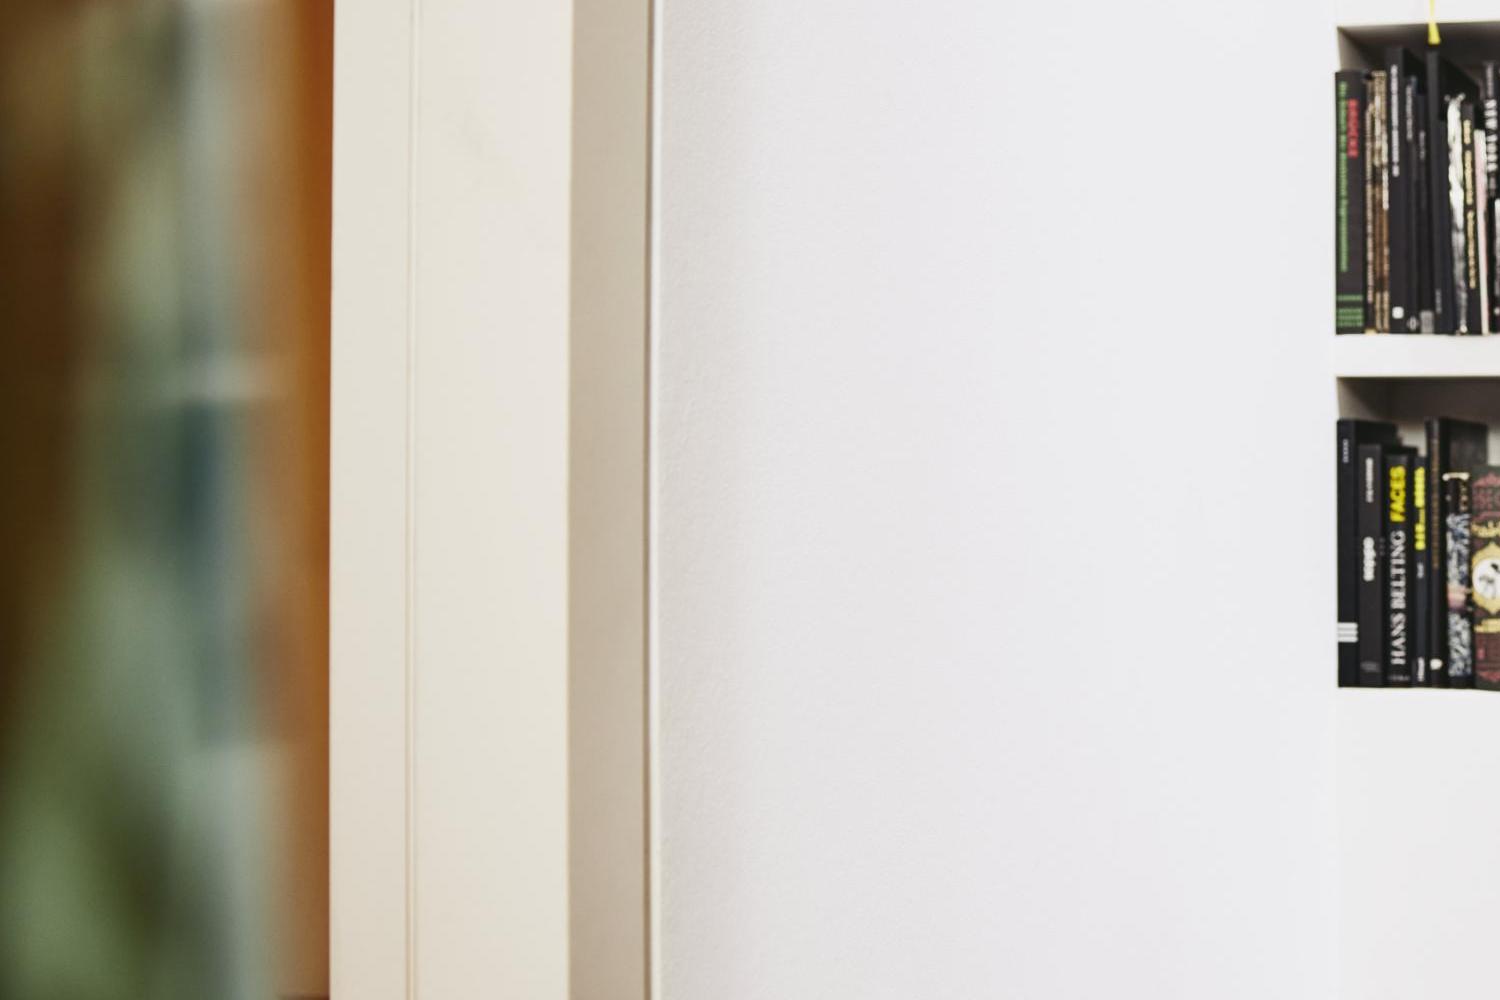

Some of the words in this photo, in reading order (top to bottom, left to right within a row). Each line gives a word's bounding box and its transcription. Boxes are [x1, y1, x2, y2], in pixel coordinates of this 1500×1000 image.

[1389, 465, 1406, 522] FACES
[1390, 530, 1406, 610] BELTING
[1390, 613, 1406, 666] HANS
